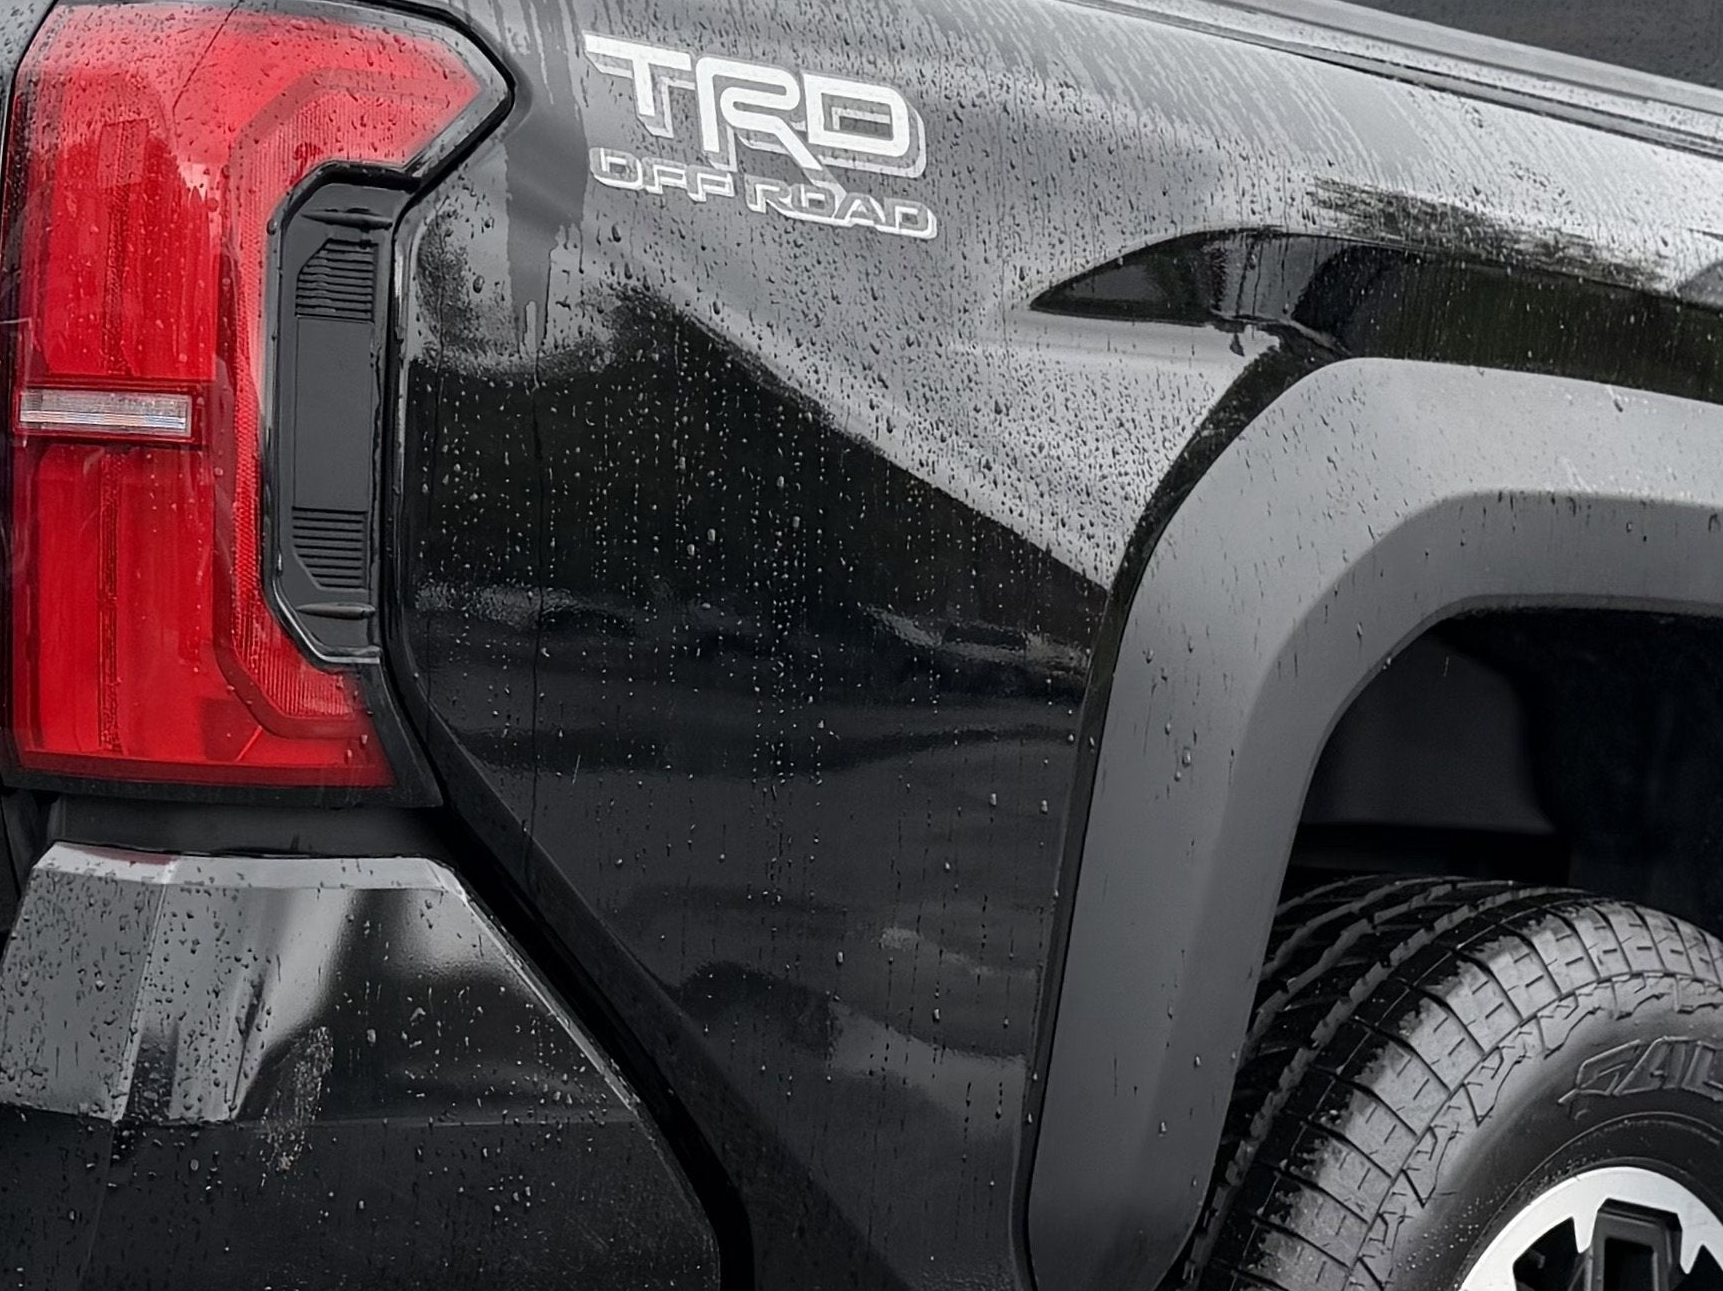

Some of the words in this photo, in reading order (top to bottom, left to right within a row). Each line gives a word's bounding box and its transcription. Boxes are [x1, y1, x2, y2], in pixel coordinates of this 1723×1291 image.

[582, 30, 926, 182] TRD
[589, 146, 736, 202] OFF
[744, 173, 938, 240] ROAD
